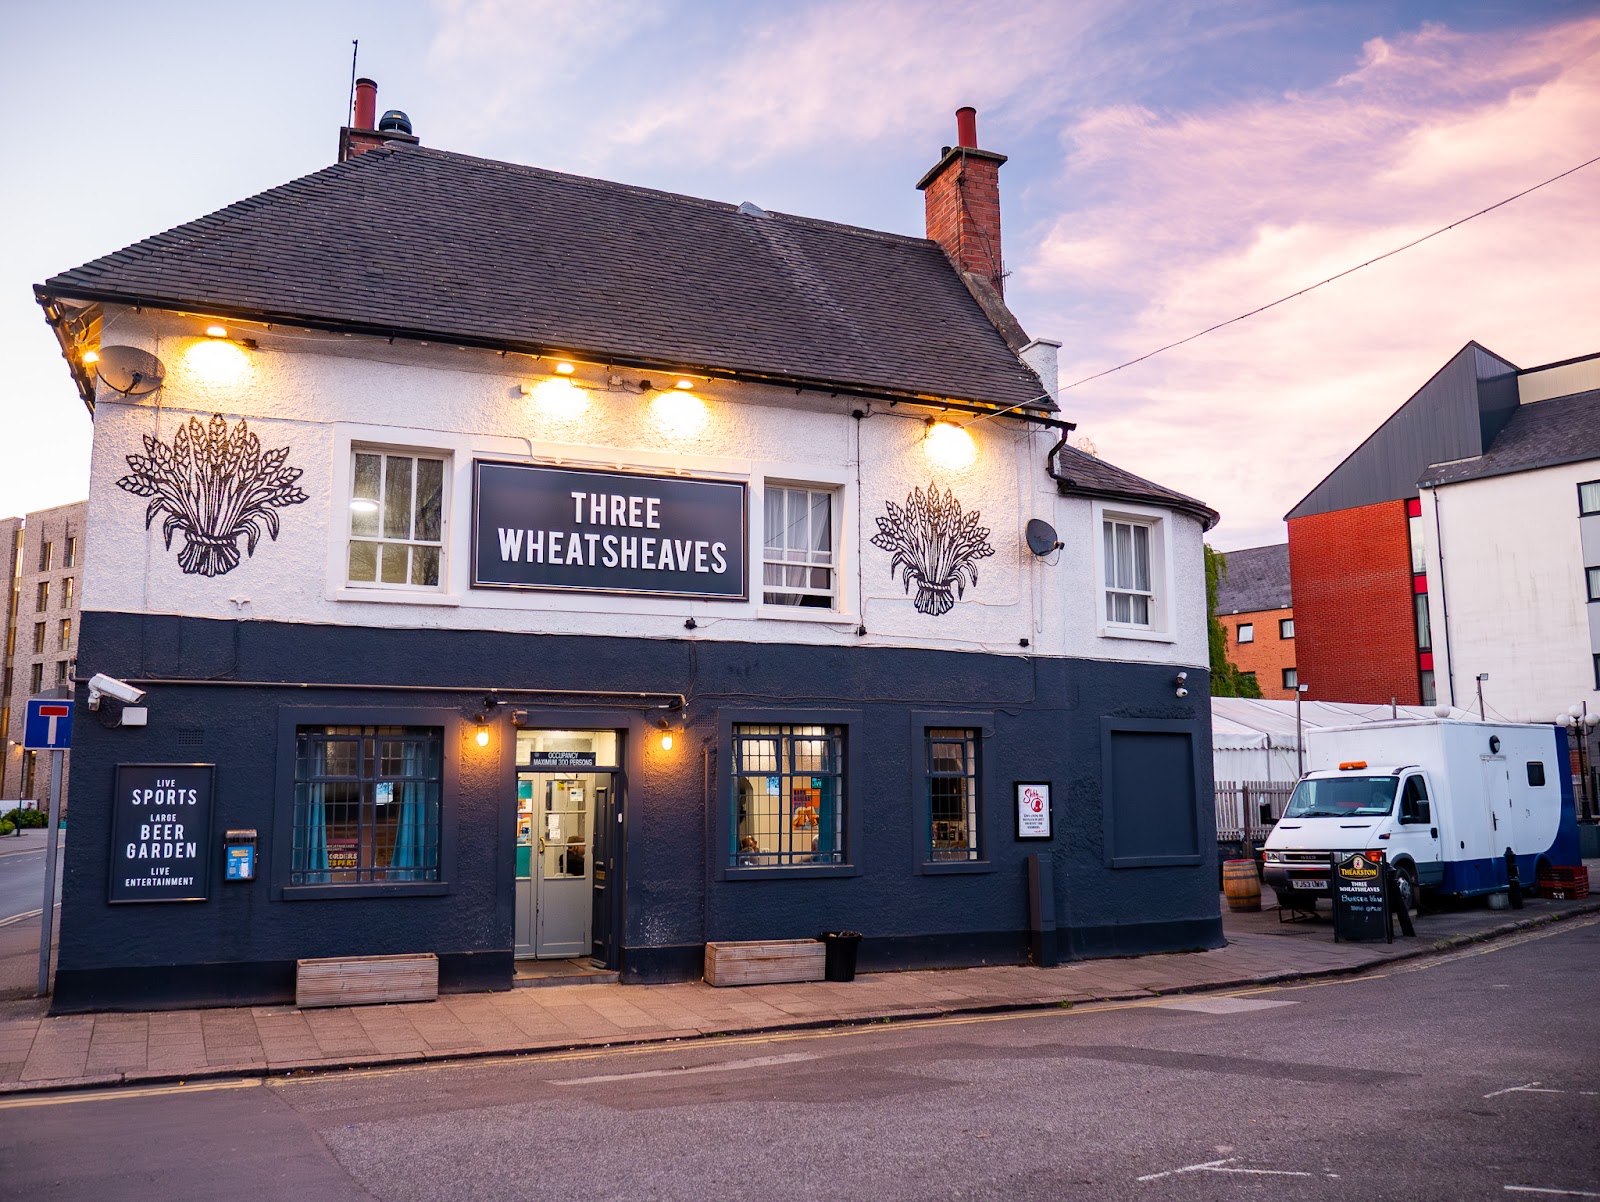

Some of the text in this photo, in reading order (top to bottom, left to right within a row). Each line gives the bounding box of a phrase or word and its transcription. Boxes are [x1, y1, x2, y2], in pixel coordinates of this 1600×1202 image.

[571, 491, 661, 529] THREE
[498, 528, 727, 574] WHEATSHEAVES
[533, 758, 593, 766] MAXIMUM 300 PERSONS
[156, 779, 176, 788] LIVE
[132, 788, 197, 806] SPORTS
[150, 813, 177, 822] LARGE
[140, 824, 184, 841] BEER
[126, 842, 197, 859] GARDEN
[151, 867, 170, 876] LIVE
[1341, 868, 1377, 876] THEAKSTON
[125, 877, 194, 887] ENTERTAINMENT
